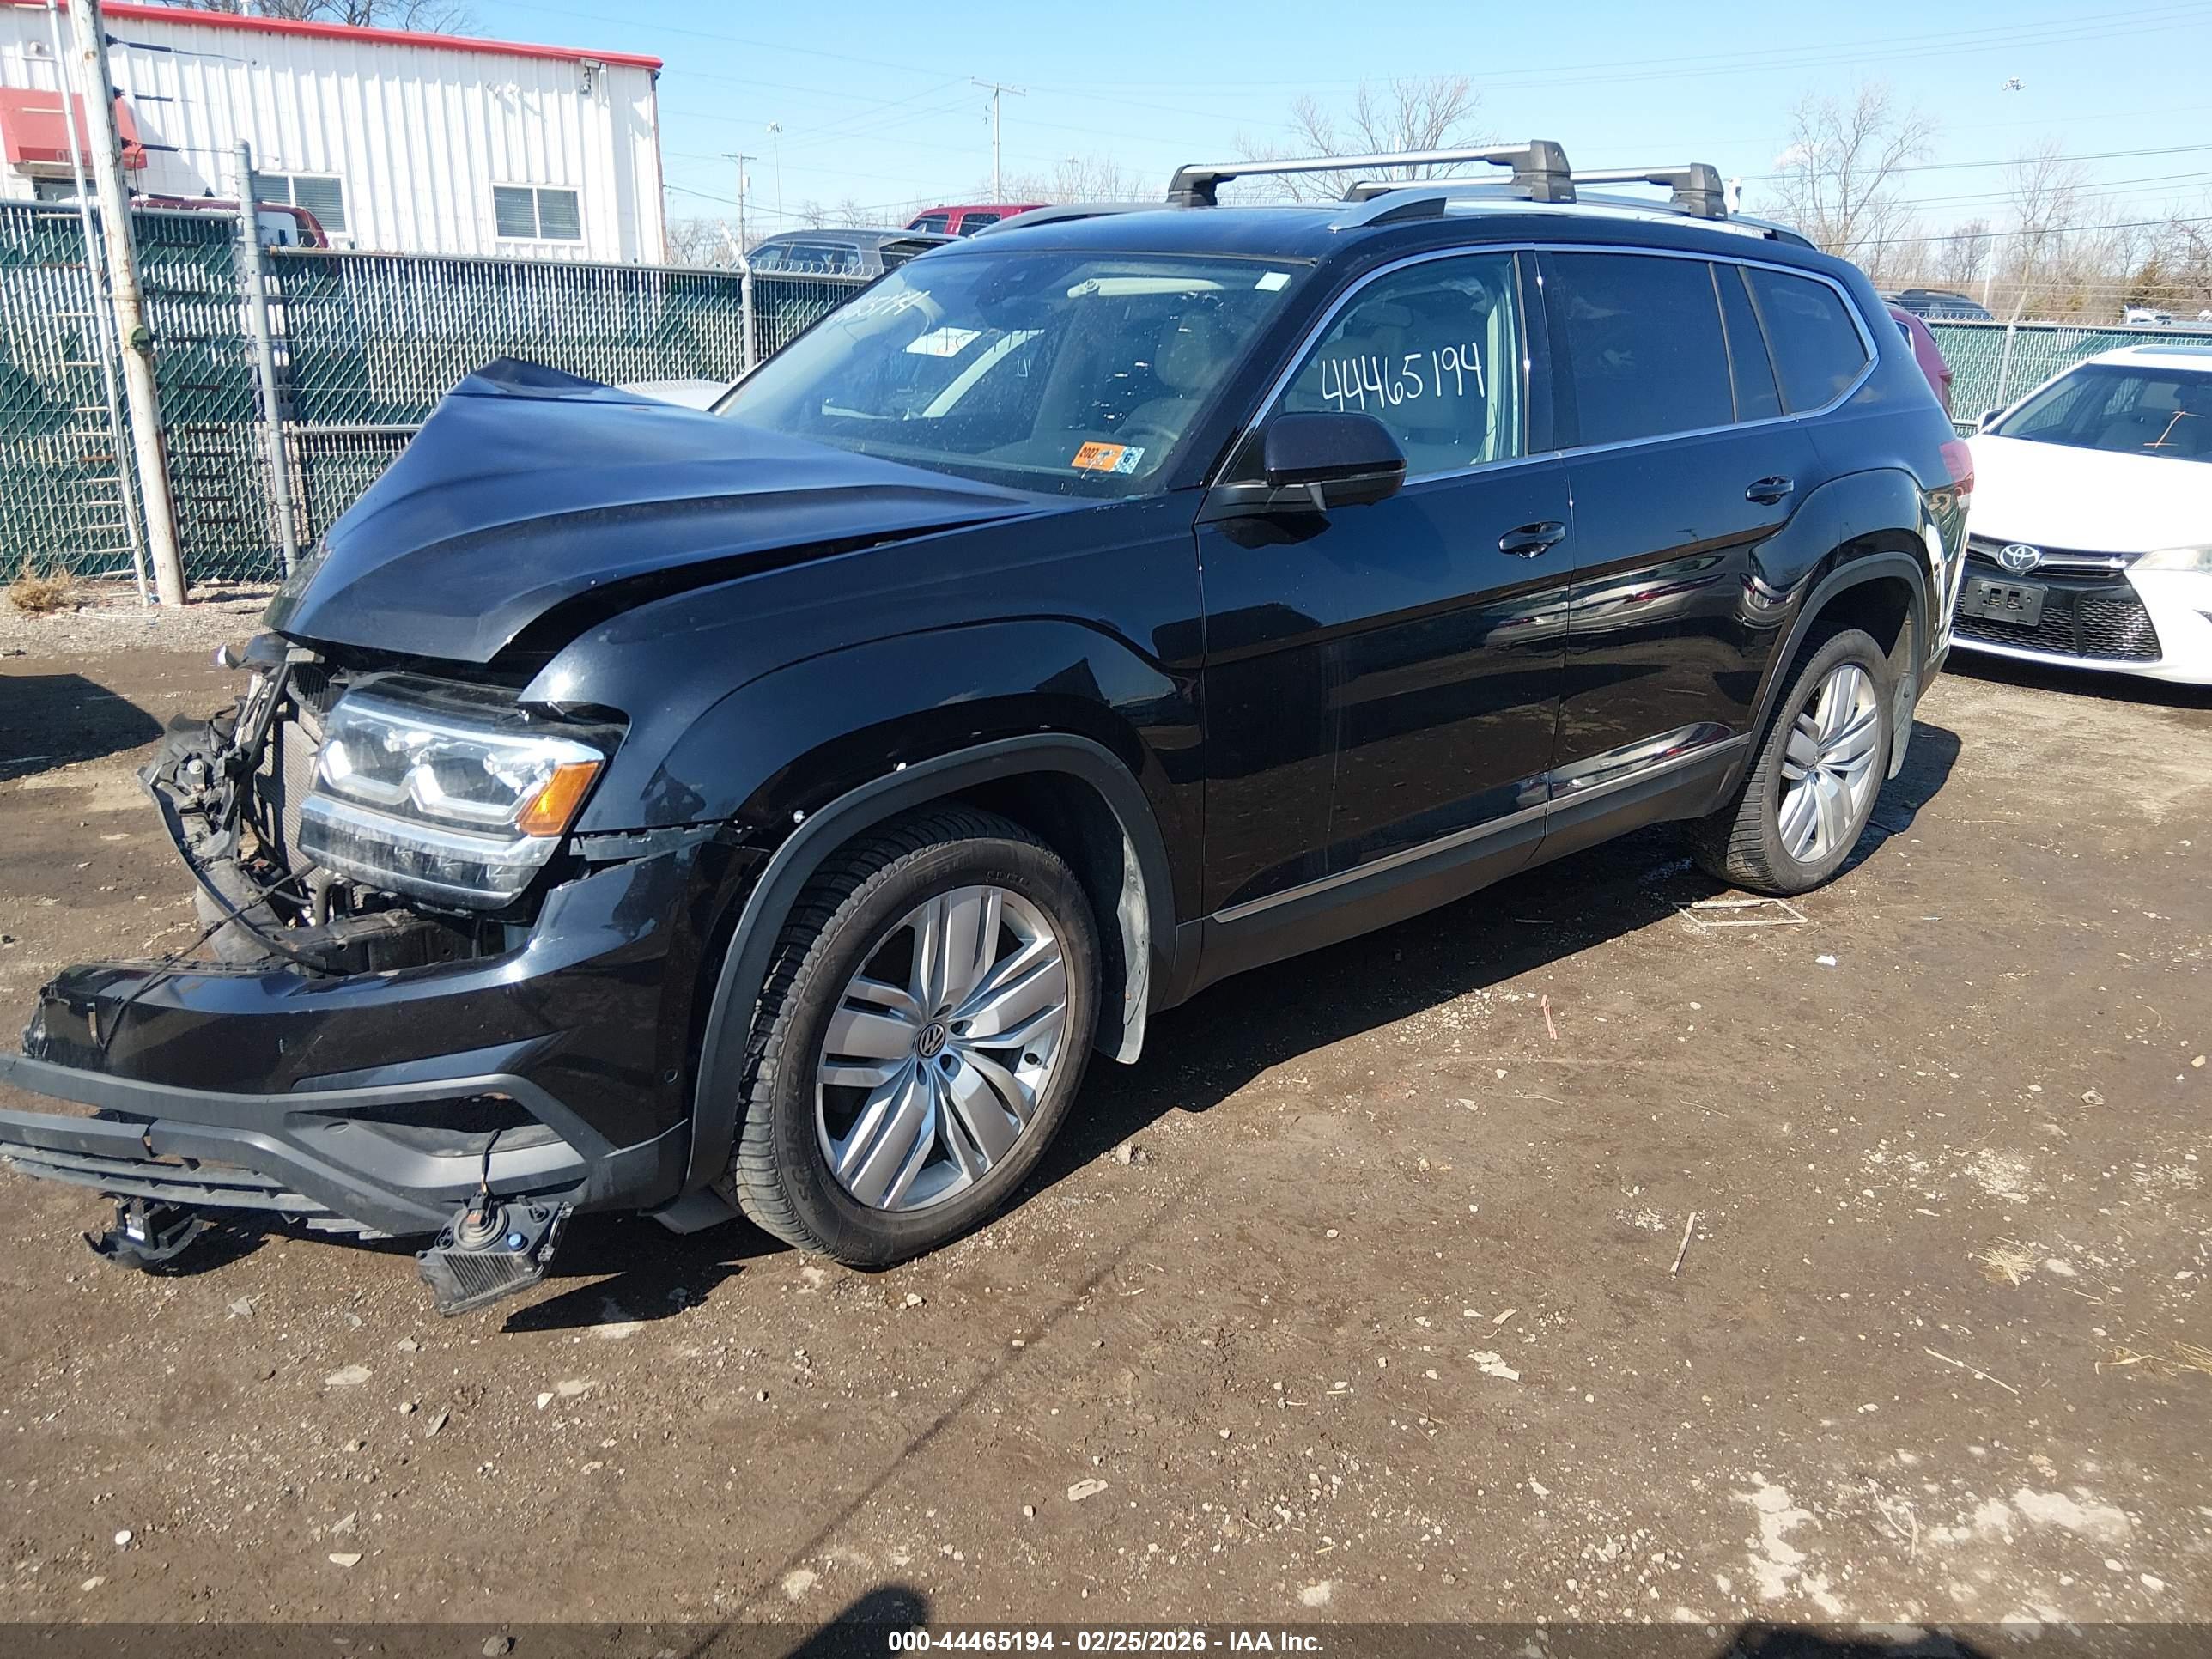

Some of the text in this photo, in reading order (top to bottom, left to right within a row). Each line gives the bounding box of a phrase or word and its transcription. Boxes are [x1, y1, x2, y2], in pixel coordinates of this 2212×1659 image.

[1321, 341, 1486, 413] 44465194
[1079, 446, 1133, 464] 2027 6
